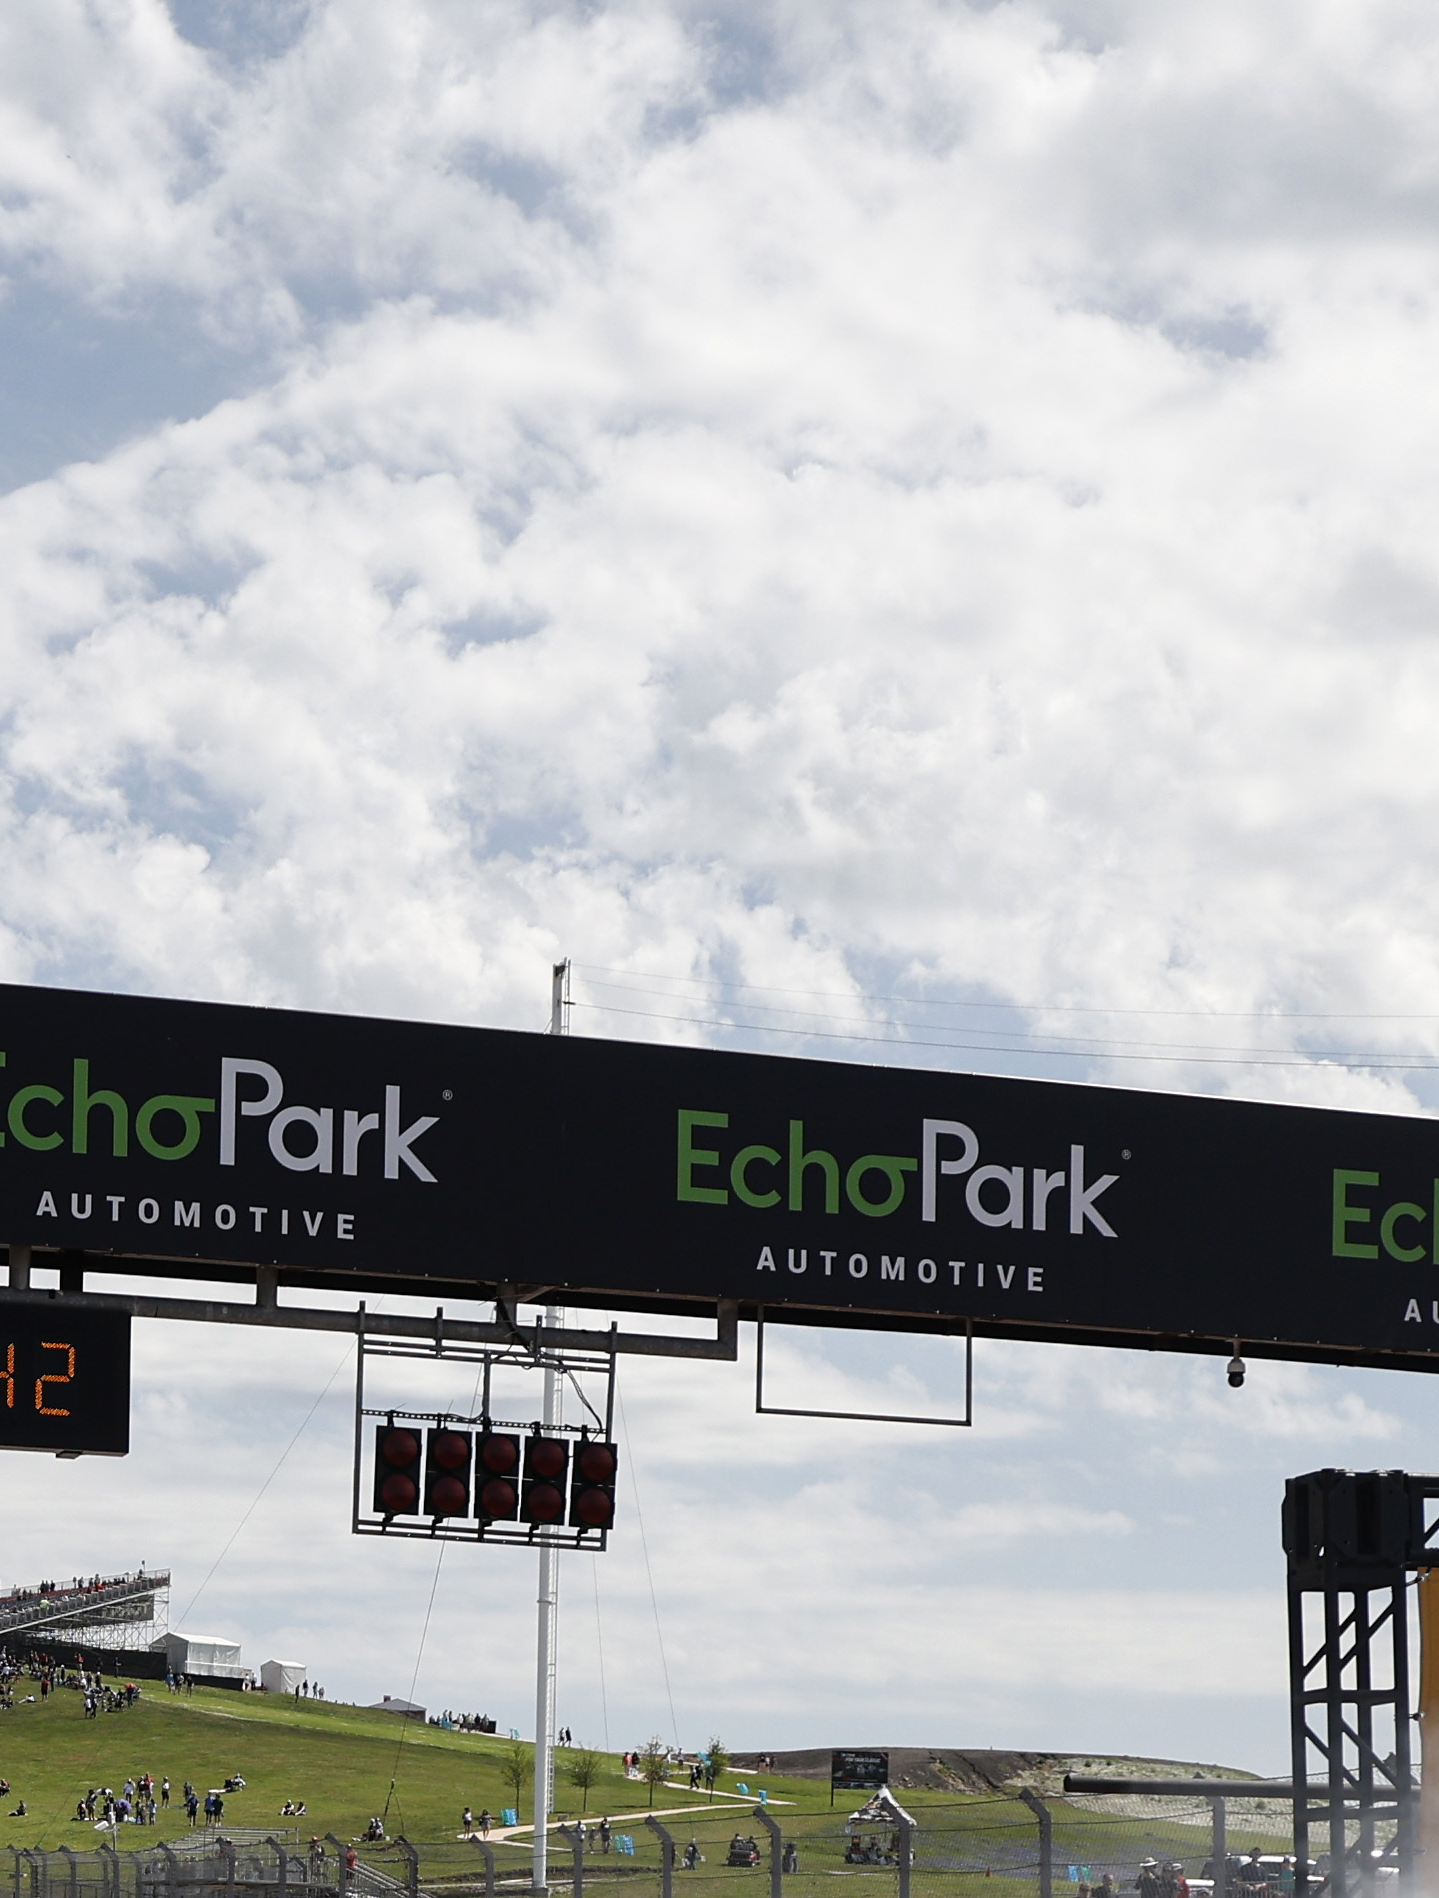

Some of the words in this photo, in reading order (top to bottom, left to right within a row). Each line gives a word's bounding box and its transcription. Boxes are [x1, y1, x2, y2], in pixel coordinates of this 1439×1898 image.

[677, 1108, 1119, 1239] EchoPark
[36, 1189, 357, 1241] AUTOMOTIVE
[756, 1245, 1046, 1294] AUTOMOTIVE
